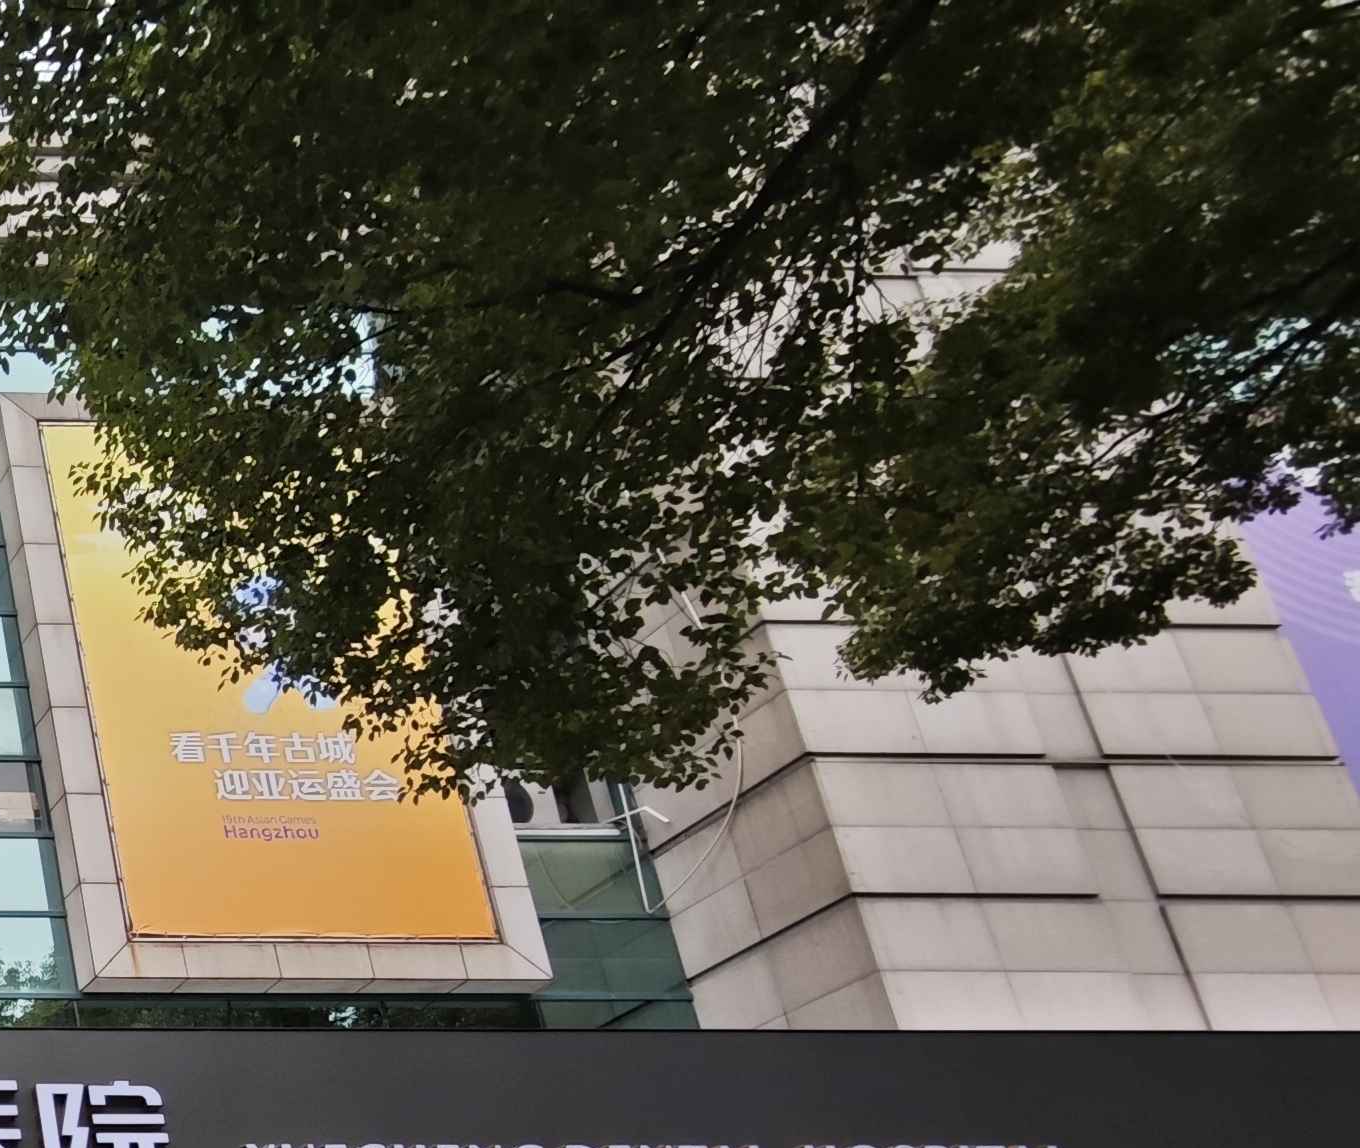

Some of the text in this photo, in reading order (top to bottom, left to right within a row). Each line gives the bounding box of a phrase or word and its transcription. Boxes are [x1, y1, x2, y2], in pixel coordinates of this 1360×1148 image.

[169, 731, 356, 764] 看千年古城
[213, 768, 402, 801] 迎亚运盛会
[221, 814, 317, 825] 19th Asian Games
[223, 825, 320, 842] Hangzhou
